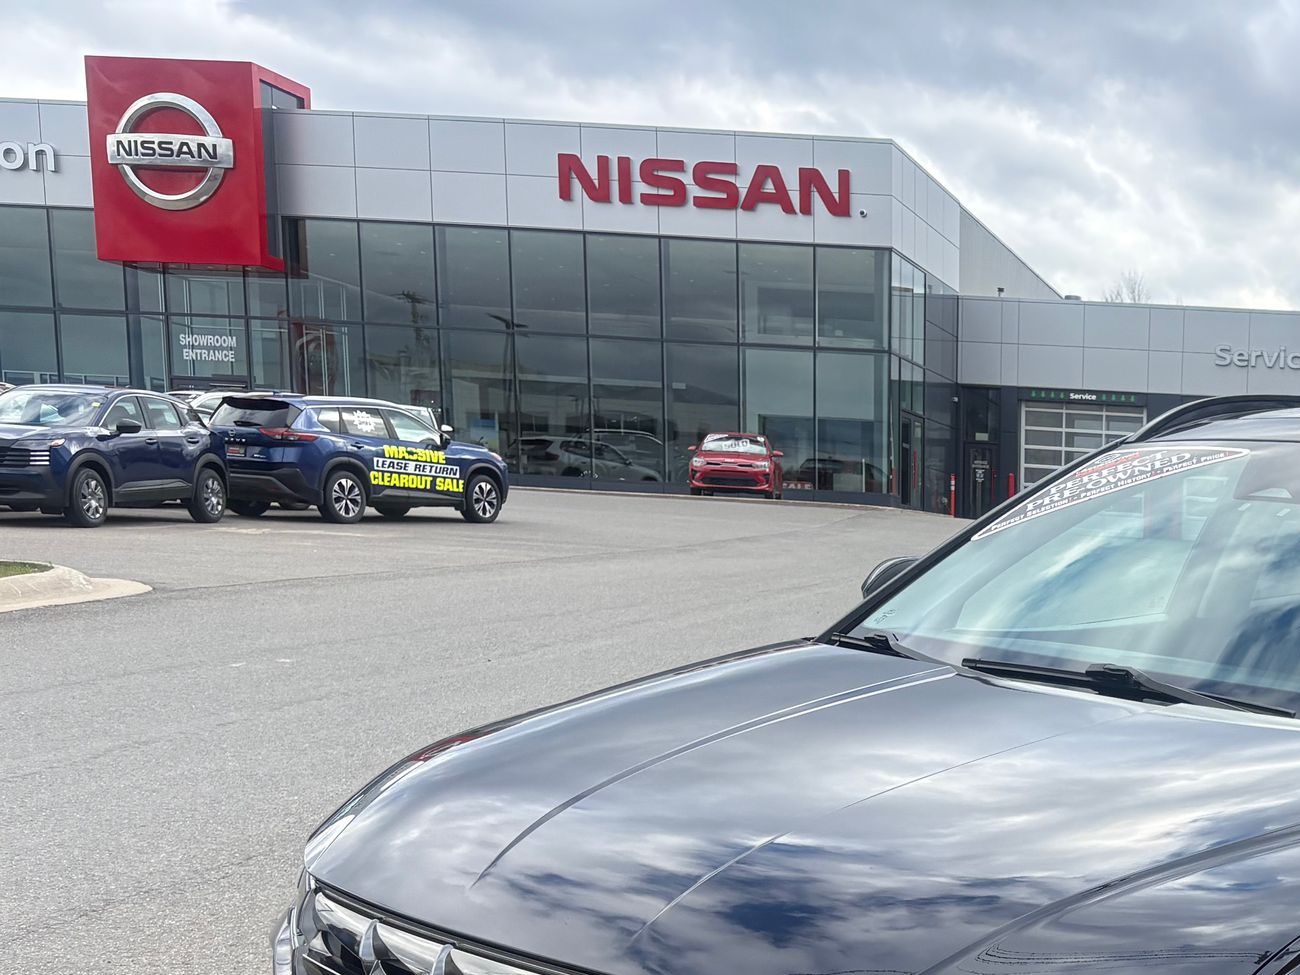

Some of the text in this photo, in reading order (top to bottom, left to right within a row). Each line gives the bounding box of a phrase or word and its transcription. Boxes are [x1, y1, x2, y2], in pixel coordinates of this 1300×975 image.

[116, 140, 218, 160] NISSAN
[557, 153, 852, 217] NISSAN
[179, 334, 237, 348] SHOWROOM
[182, 348, 236, 362] ENTRANCE
[1069, 392, 1097, 400] Service
[375, 459, 458, 477] LEASE RETURN
[1049, 450, 1168, 495] PERFECT
[369, 471, 465, 493] CLEAROUT SALE
[1026, 452, 1192, 512] PRE-OWNED
